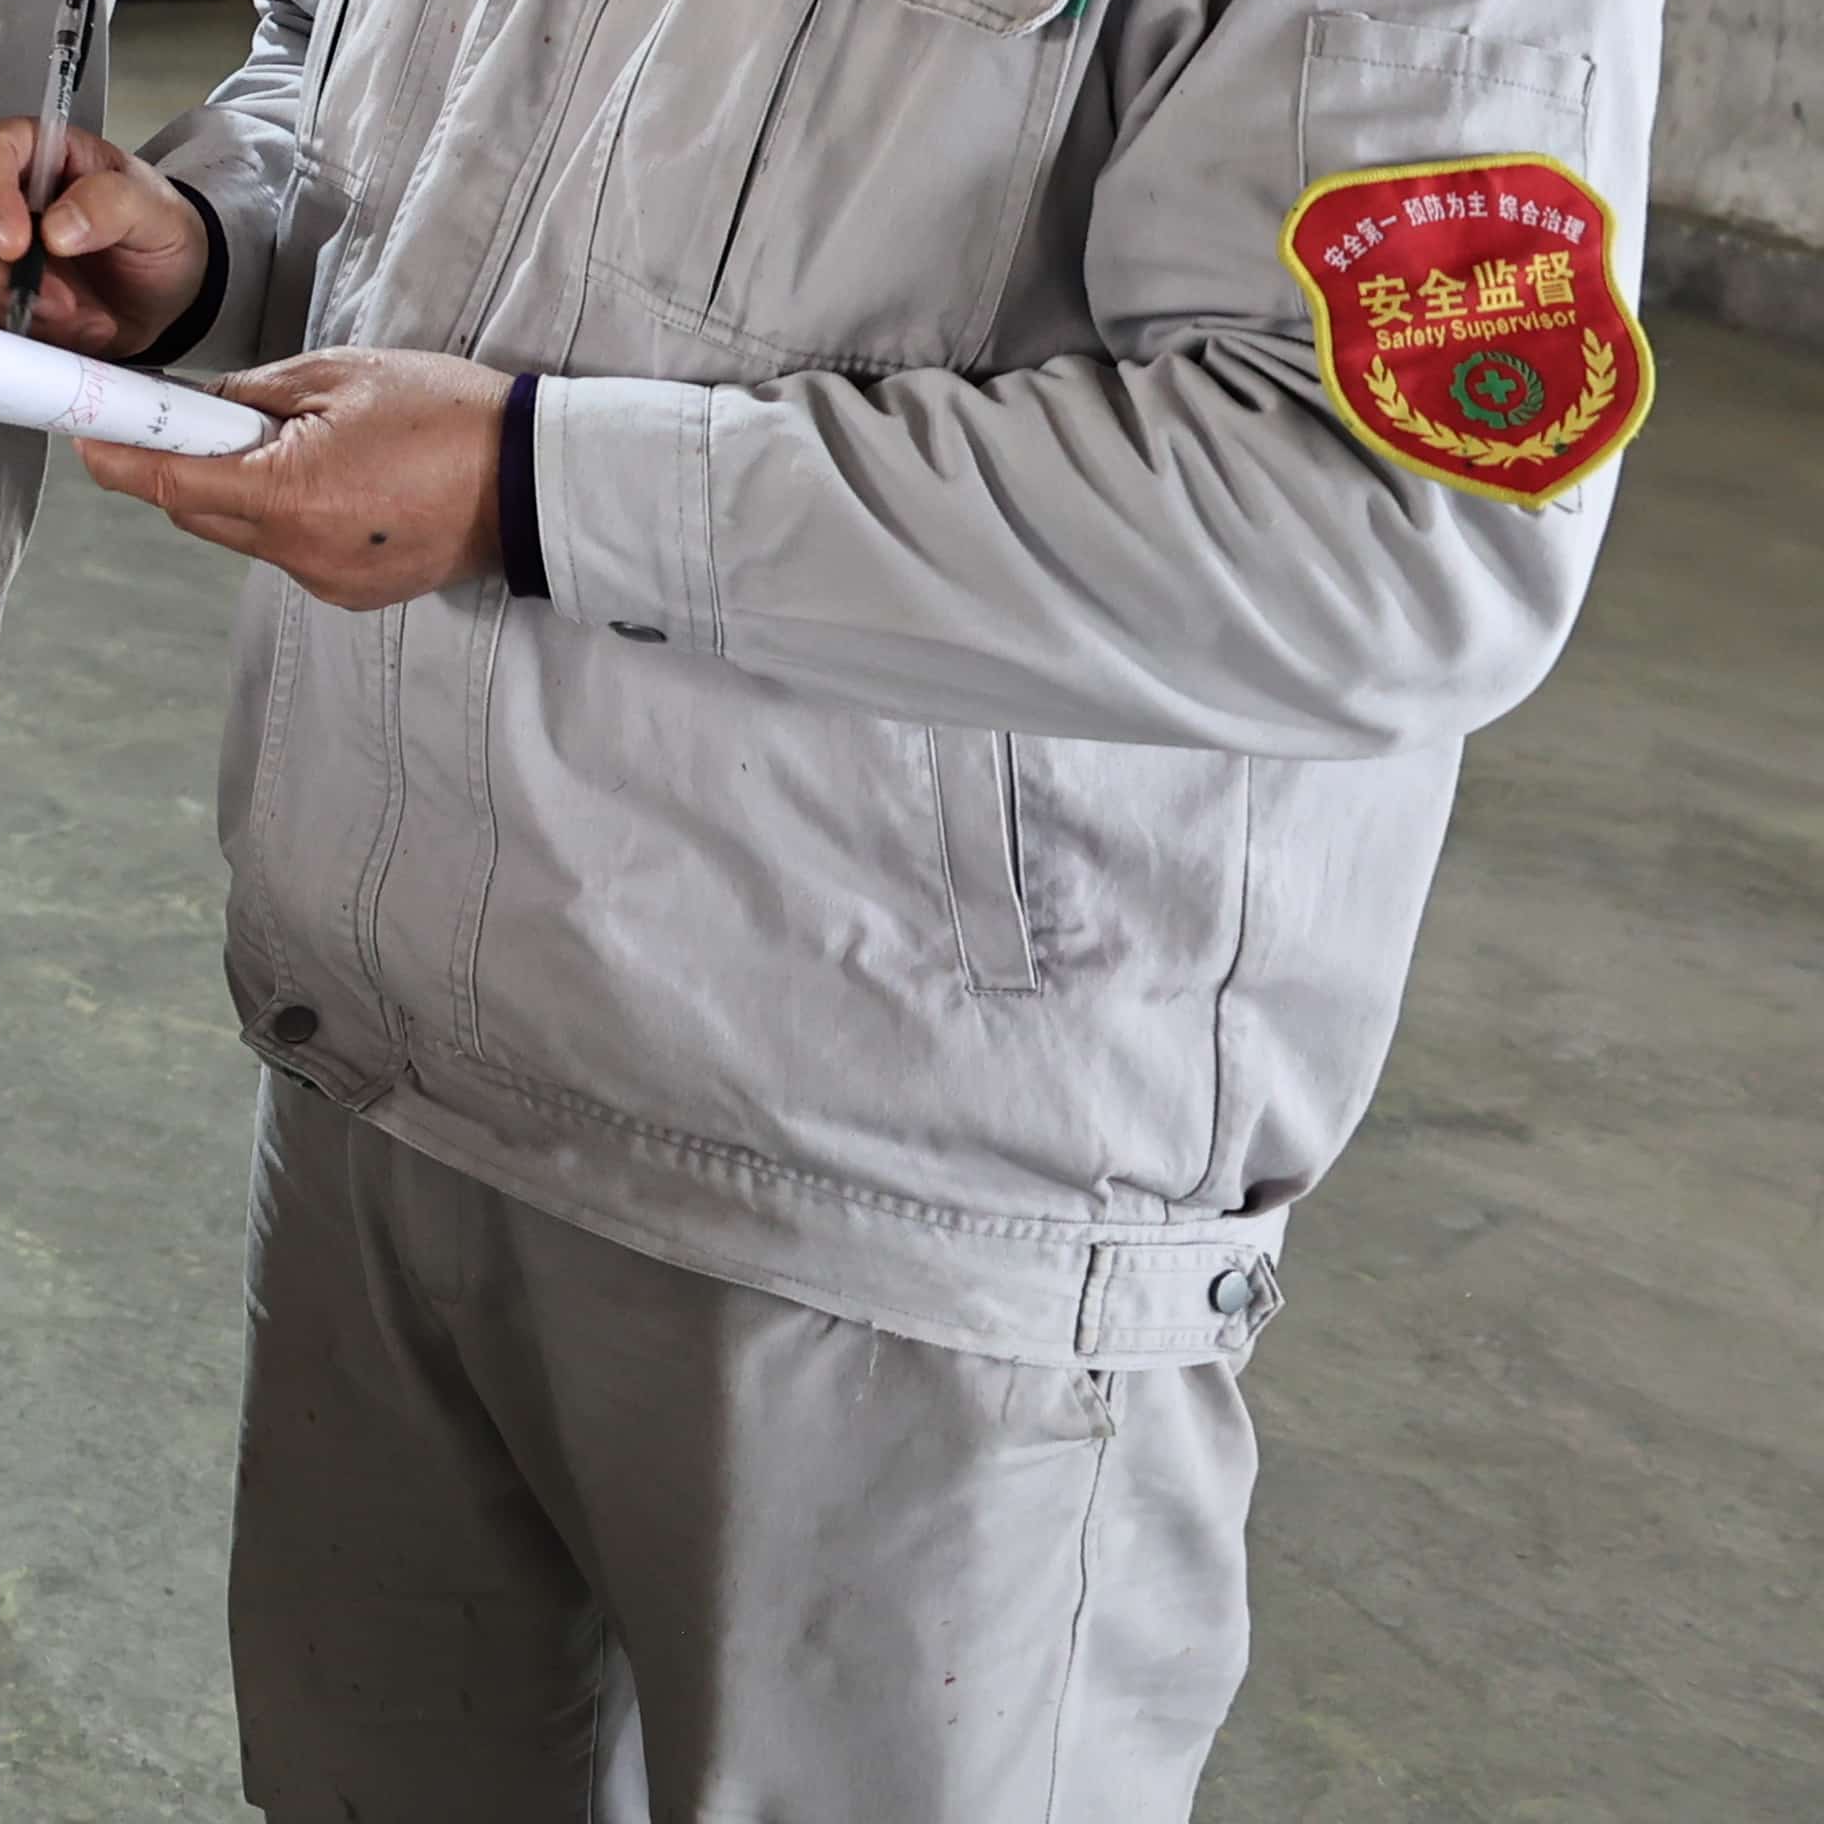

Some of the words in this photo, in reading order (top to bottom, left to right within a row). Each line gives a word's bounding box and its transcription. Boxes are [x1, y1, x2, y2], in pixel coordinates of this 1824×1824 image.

[1323, 214, 1399, 273] 安全第一
[1402, 190, 1489, 227] 预防为主
[1498, 192, 1587, 245] 综合治理
[1356, 249, 1577, 328] 安全监督
[1375, 320, 1448, 352] Safety
[1451, 308, 1578, 344] Supervisor
